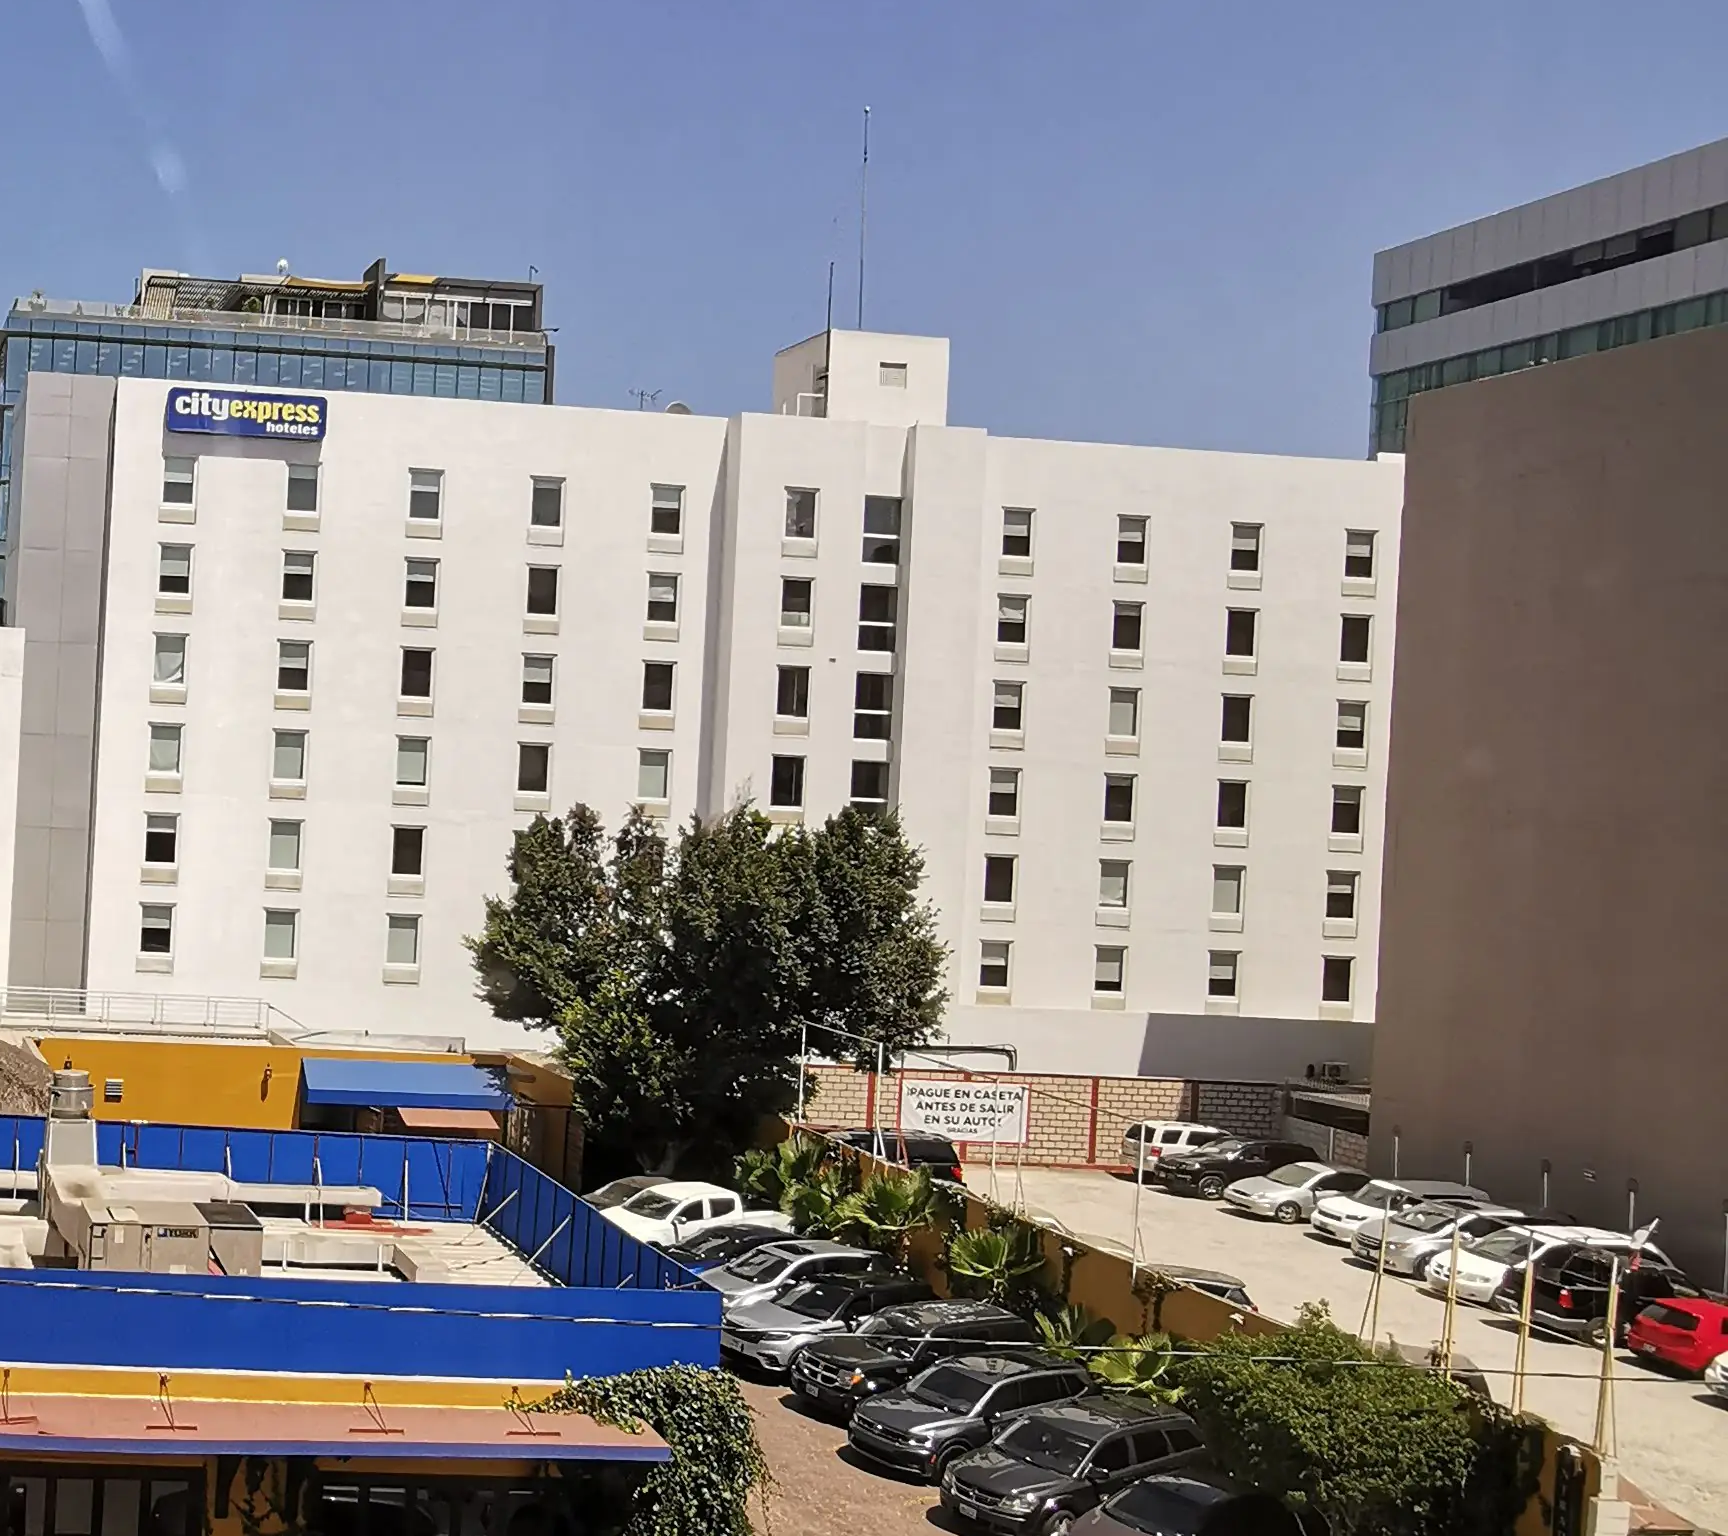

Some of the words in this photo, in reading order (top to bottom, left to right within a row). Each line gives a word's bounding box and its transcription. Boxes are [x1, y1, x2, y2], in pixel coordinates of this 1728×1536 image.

[265, 421, 319, 436] hoteles
[953, 1089, 971, 1099] EN
[973, 1090, 1022, 1101] CASETA
[915, 1101, 957, 1112] ANTES
[959, 1103, 977, 1113] DE
[979, 1103, 1015, 1114] SALIR
[923, 1114, 941, 1125] EN
[943, 1115, 961, 1125] SU
